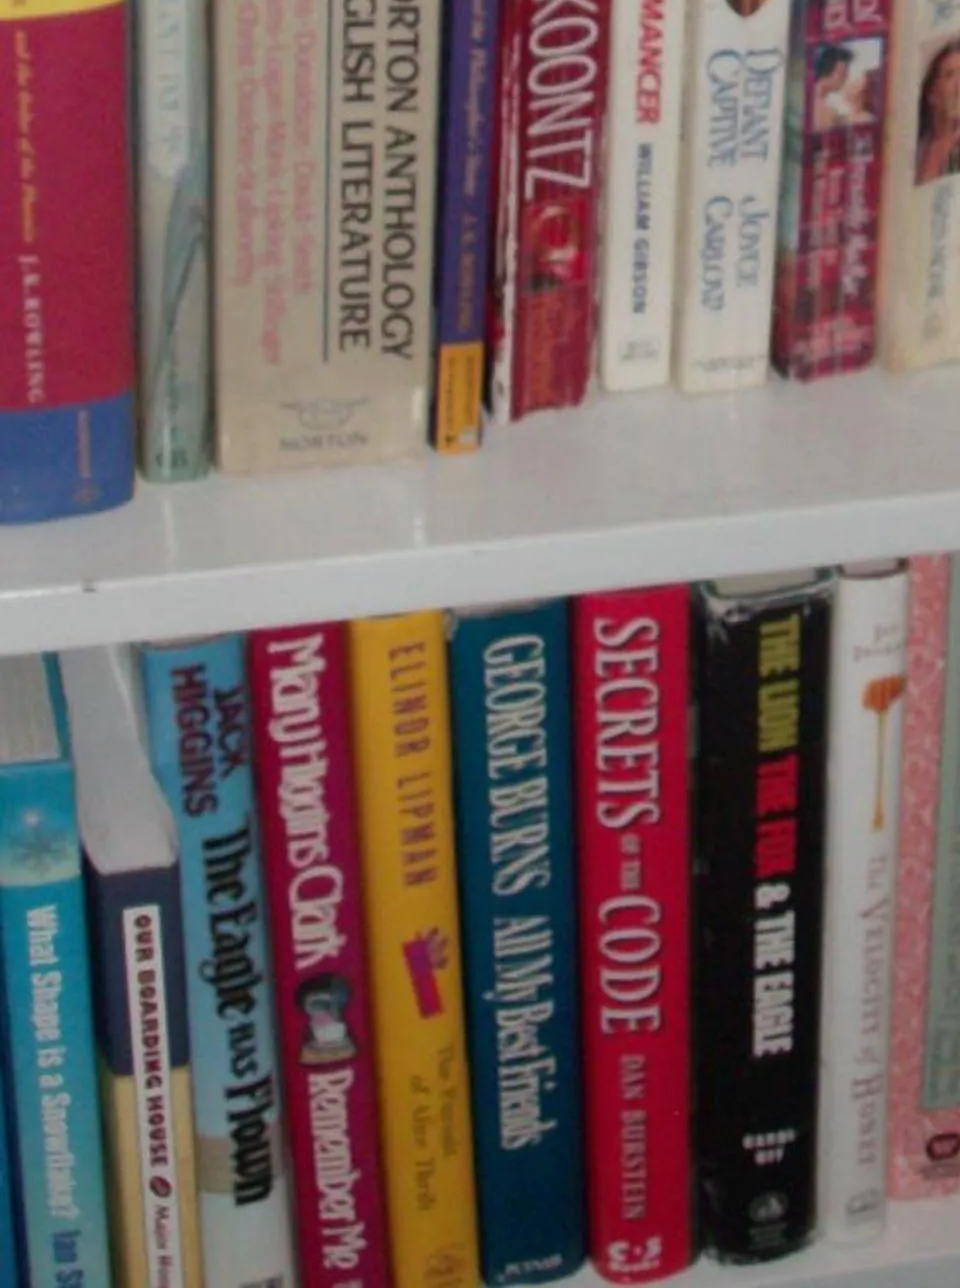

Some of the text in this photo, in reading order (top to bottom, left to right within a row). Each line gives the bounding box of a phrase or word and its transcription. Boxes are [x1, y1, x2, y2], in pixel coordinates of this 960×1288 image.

[703, 48, 745, 170] CAPTIVE
[739, 47, 787, 162] DEFIANT
[337, 120, 377, 353] LITERATURE
[380, 126, 420, 360] ANTHOLOGY
[628, 141, 653, 315] WILLIAM GIBSON
[734, 194, 772, 289] JOYCE
[170, 664, 220, 818] HIGGINS
[211, 683, 251, 779] JACK
[756, 614, 798, 753] THE LION
[264, 634, 346, 969] Mary Higgins Clark
[387, 640, 440, 888] ELINOR LIPMAN
[482, 633, 550, 896] GEORGE BURNS
[592, 615, 664, 1036] SECRETS CODE
[754, 754, 796, 881] THE FOX
[26, 904, 59, 966] What
[750, 882, 797, 1060] & THE EAGLE
[859, 896, 892, 1035] VELOCITY
[31, 970, 64, 1042] Shape
[134, 912, 169, 1167] OUR BOARDING HOUSE
[196, 825, 275, 1208] The Eagle Flown
[482, 915, 557, 1152] All My Best Friends
[40, 1074, 60, 1088] a
[620, 1052, 644, 1101] DAN
[39, 1091, 80, 1219] Snowflake?
[305, 1068, 366, 1269] Remember Me
[620, 1107, 647, 1220] BURSTEIN
[51, 1229, 82, 1263] Ian
